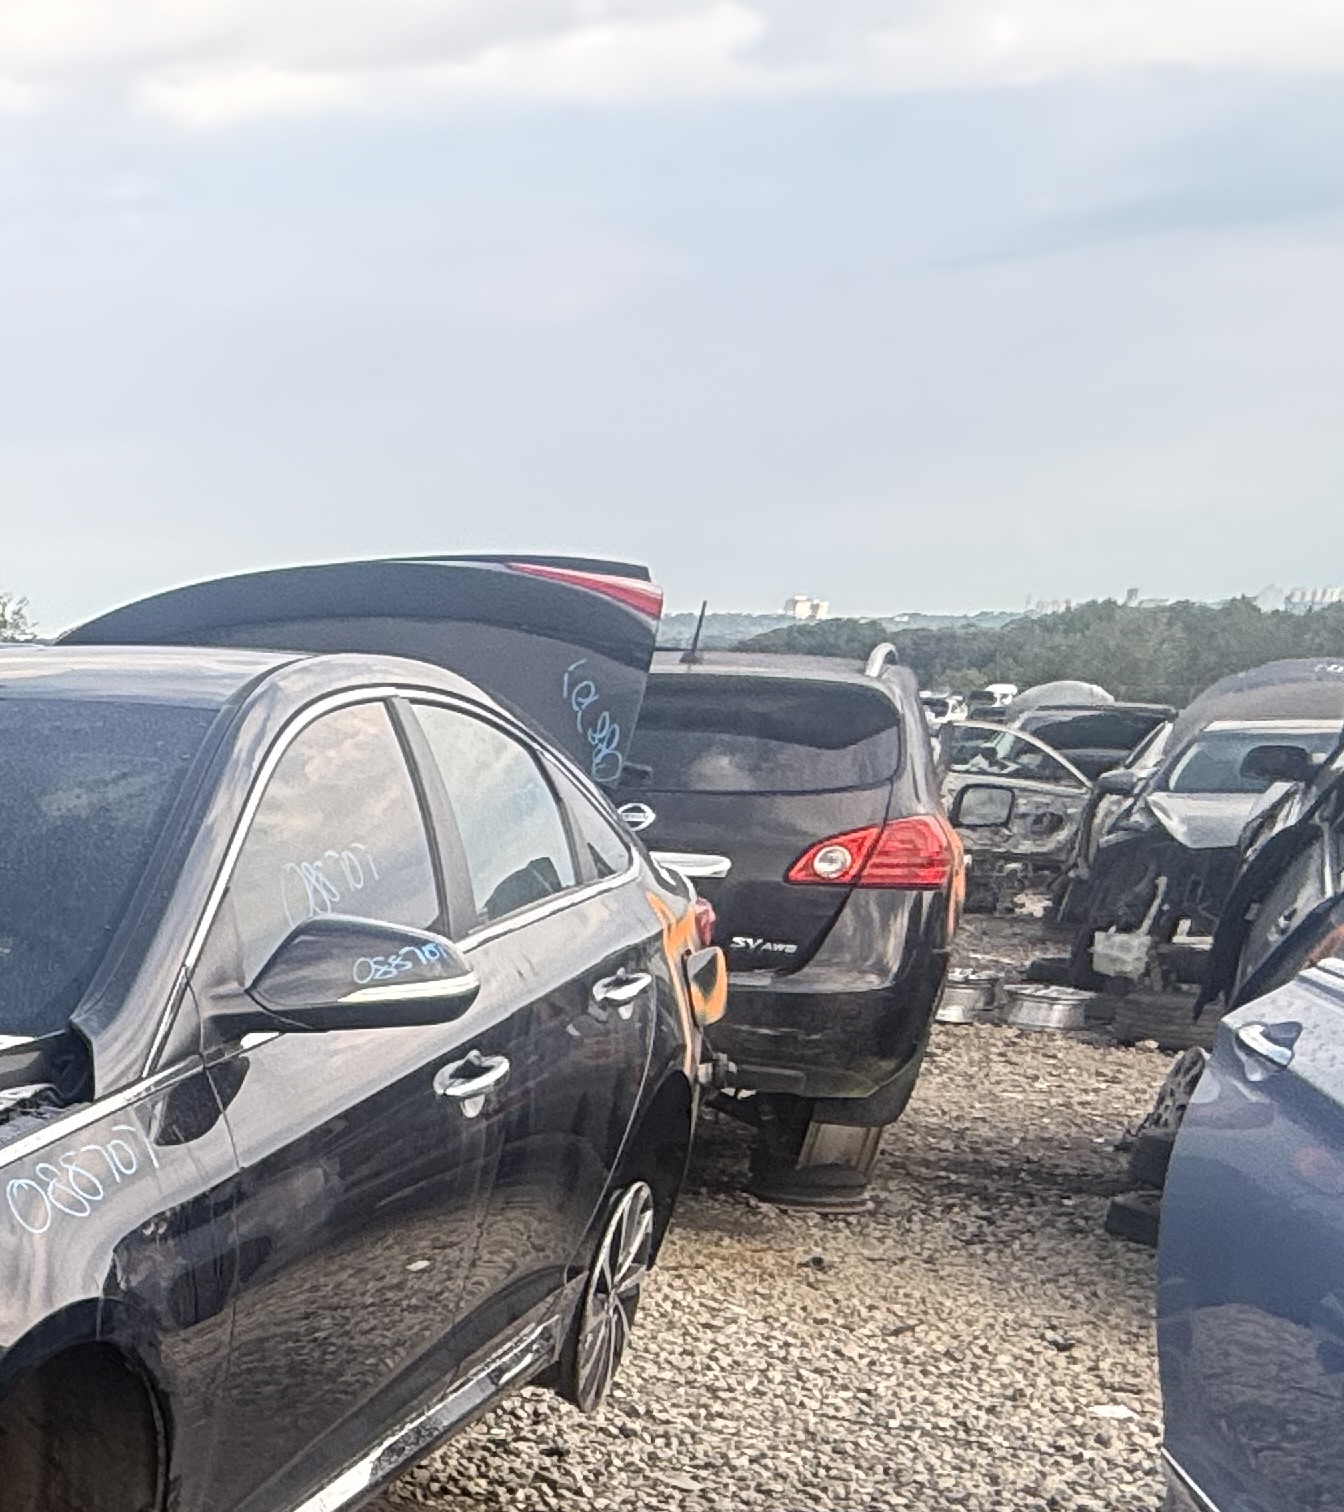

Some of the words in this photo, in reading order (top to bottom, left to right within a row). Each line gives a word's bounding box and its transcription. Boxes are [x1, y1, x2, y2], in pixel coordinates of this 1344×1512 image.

[730, 936, 764, 951] SV
[761, 942, 798, 954] AWD
[6, 1124, 160, 1234] 088707
